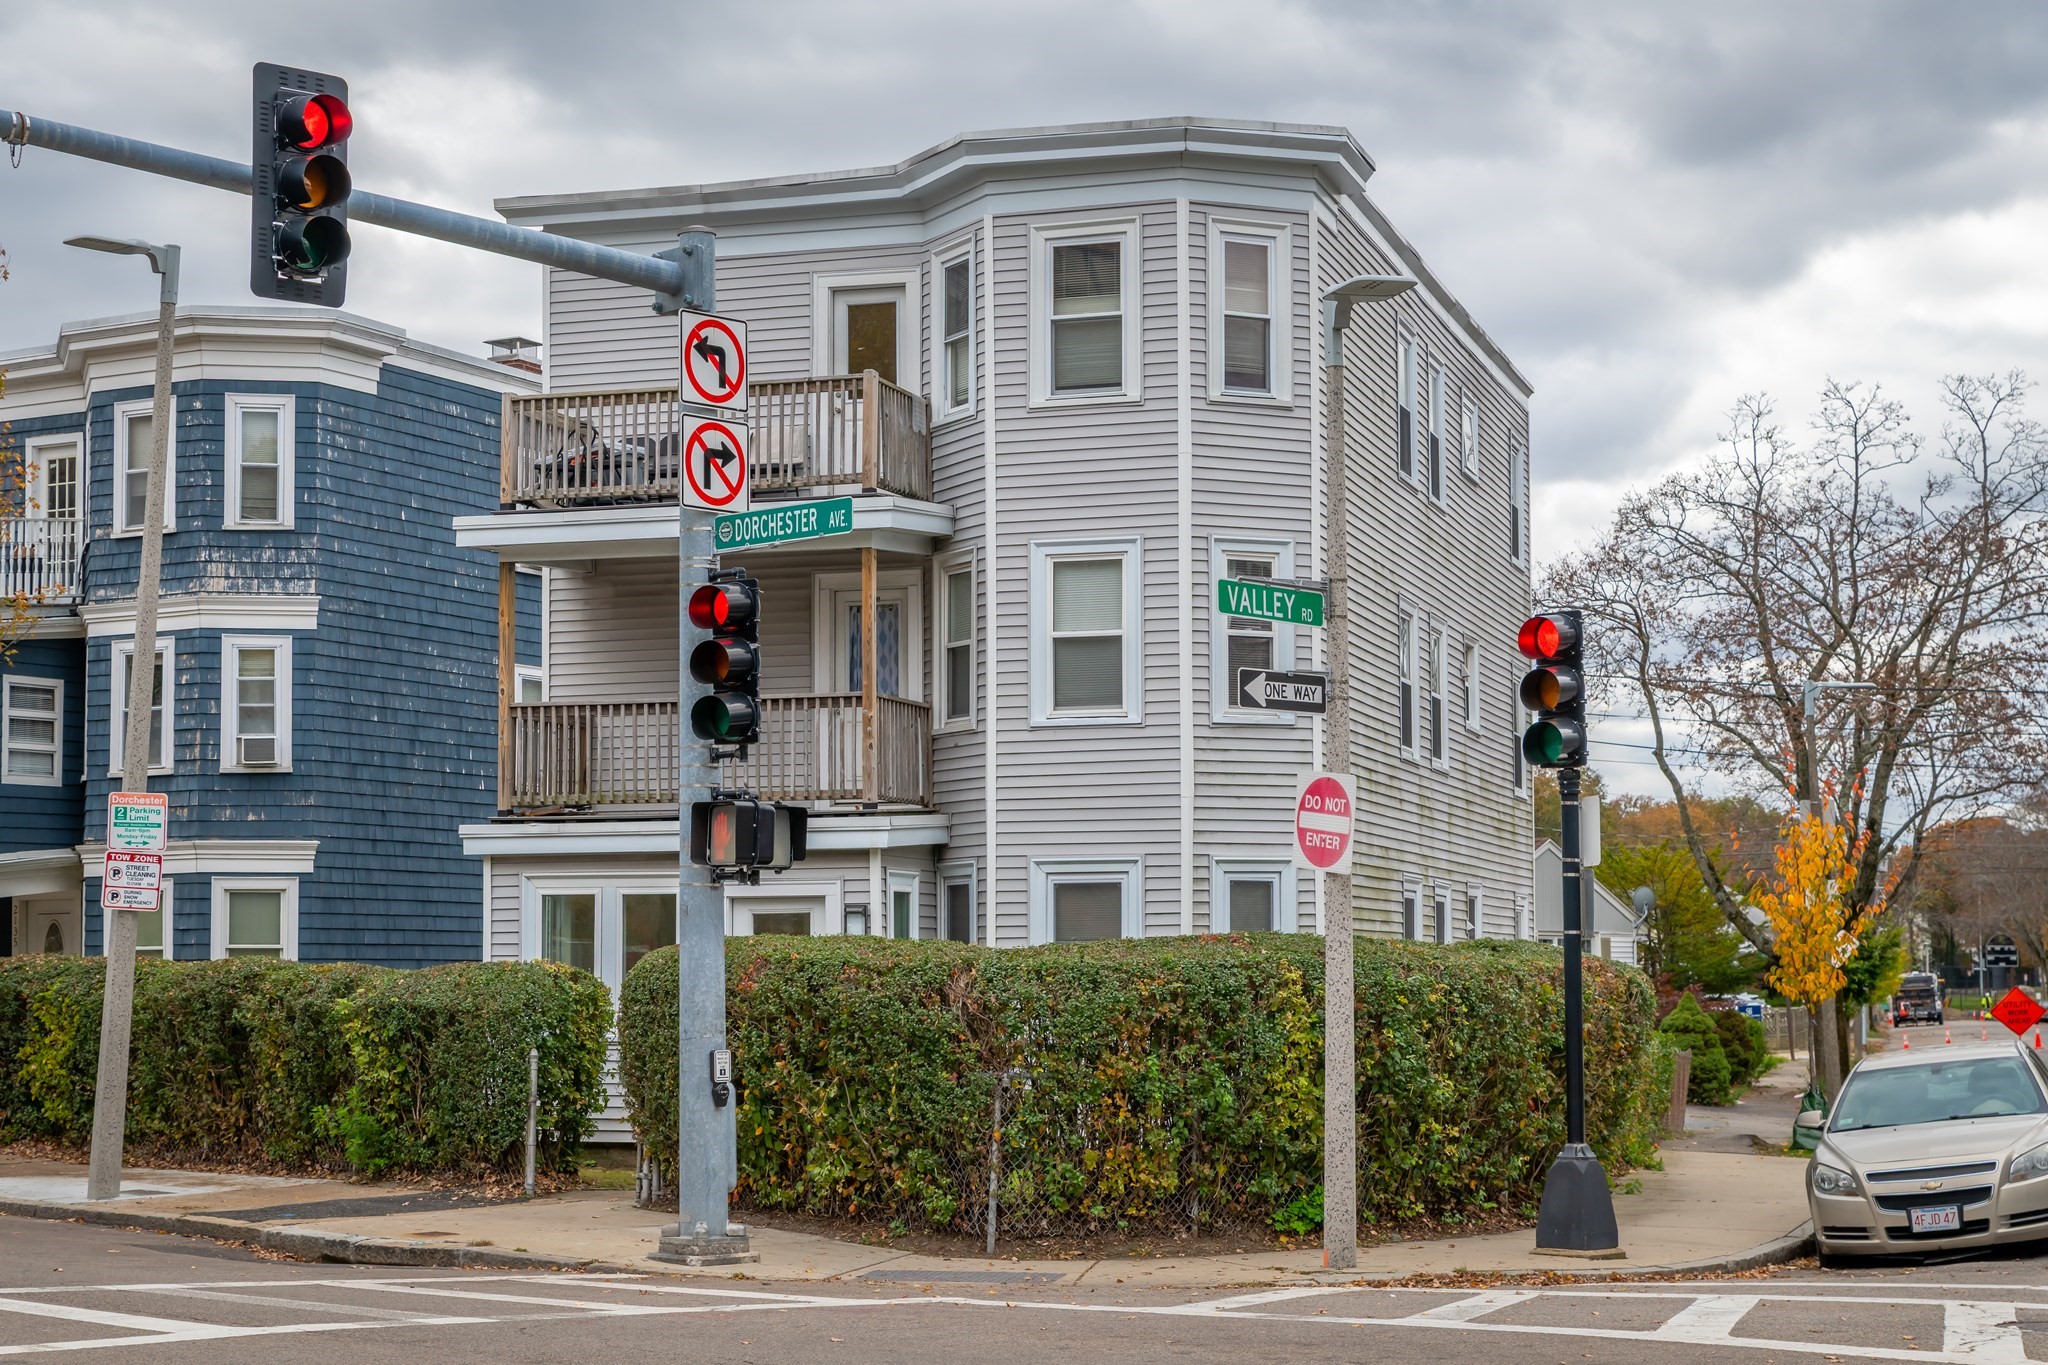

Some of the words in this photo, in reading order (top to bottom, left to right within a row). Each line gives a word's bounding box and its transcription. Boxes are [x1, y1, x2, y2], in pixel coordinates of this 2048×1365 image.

[735, 508, 817, 541] DORCHESTER
[828, 509, 848, 529] AVE.
[1227, 585, 1296, 619] VALLEY
[1301, 608, 1313, 622] RD
[1264, 683, 1288, 699] ONE
[1293, 685, 1318, 701] WAY
[112, 795, 164, 805] Dorchester
[1304, 794, 1321, 810] DO
[1325, 797, 1346, 813] NOT
[117, 807, 125, 817] 2
[129, 807, 161, 815] Parking
[1305, 831, 1340, 850] ENTER
[133, 855, 159, 863] ZONE
[1914, 1213, 1926, 1227] 4F
[1928, 1212, 1941, 1225] JD
[1943, 1211, 1956, 1224] 47
